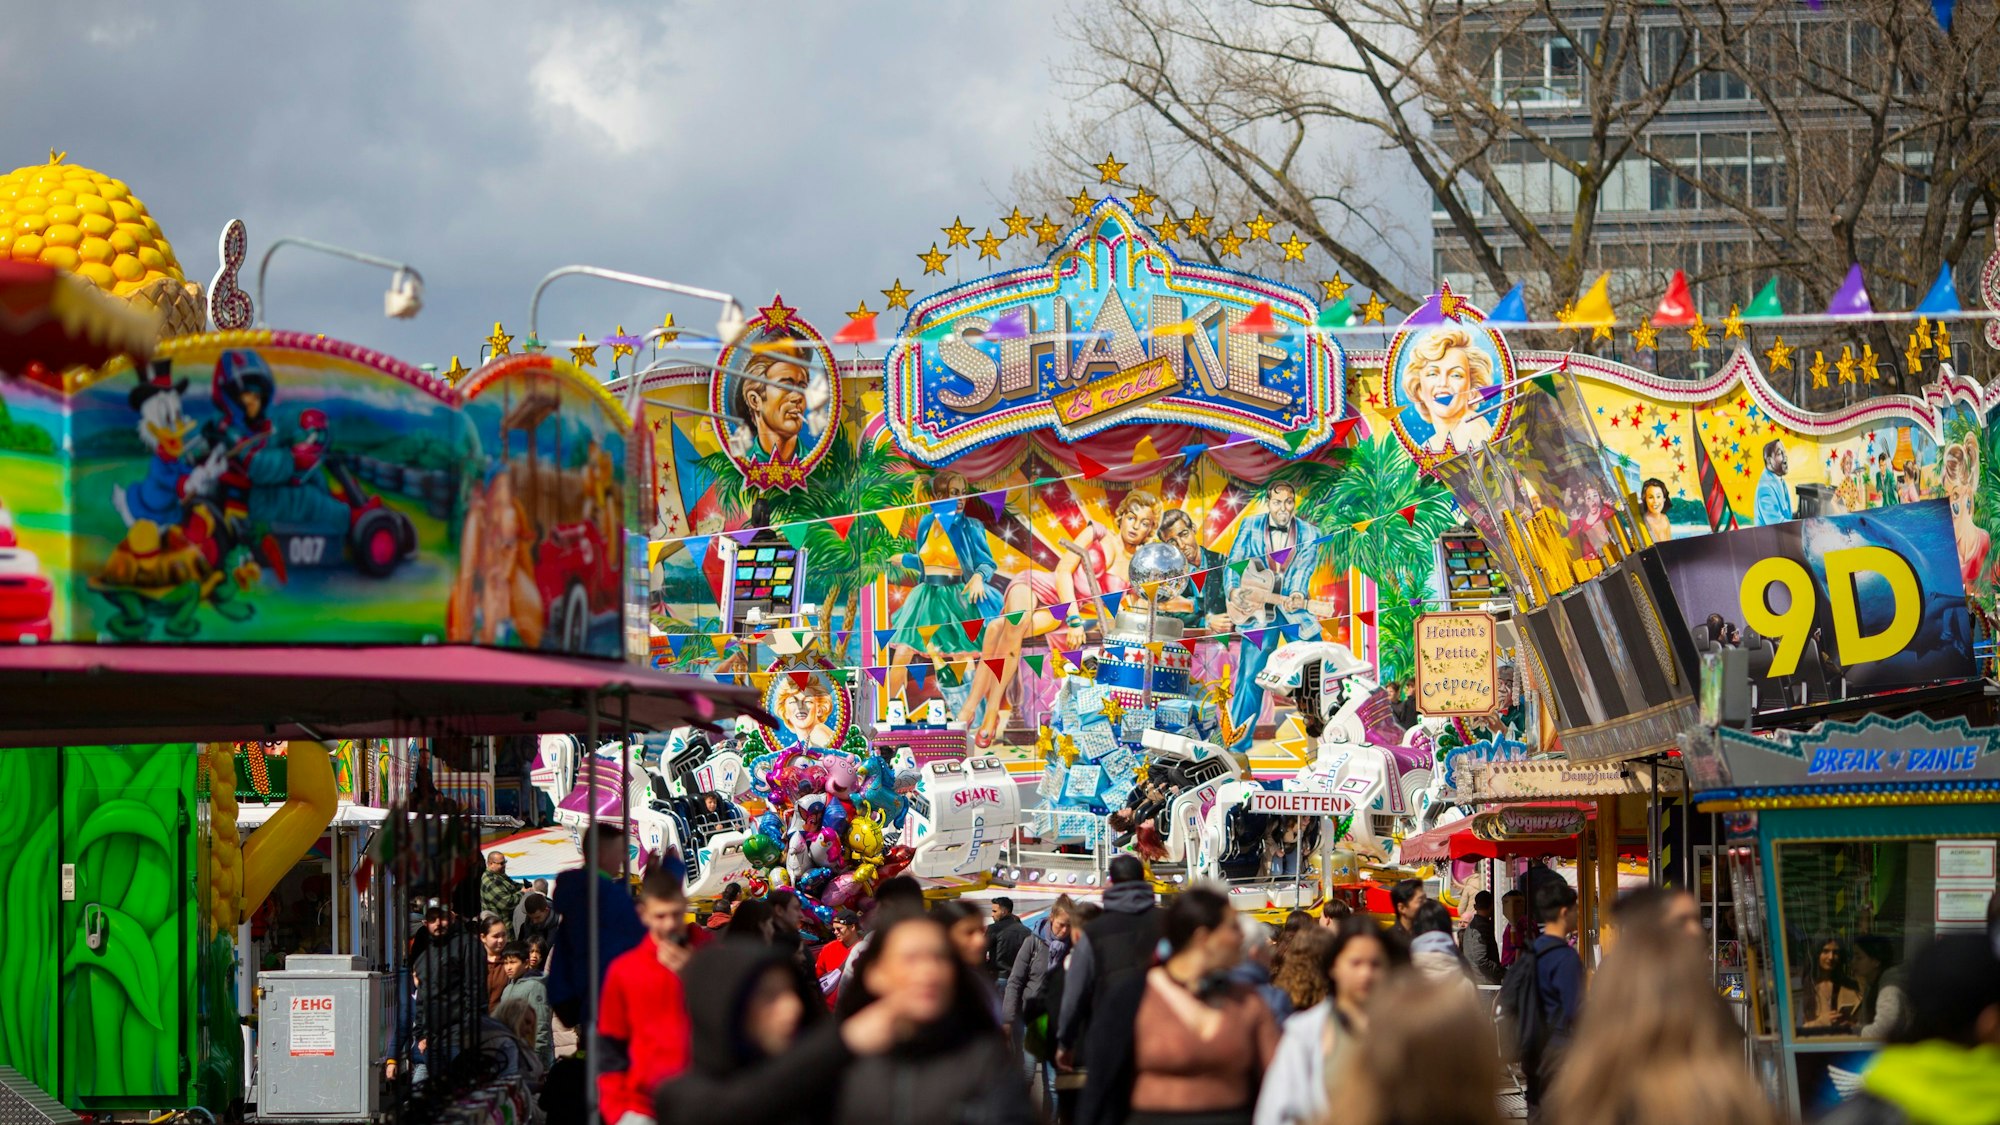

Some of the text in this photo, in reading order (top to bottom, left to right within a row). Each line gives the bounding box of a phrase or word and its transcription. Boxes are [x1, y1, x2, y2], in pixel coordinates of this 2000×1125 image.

[937, 282, 1293, 408] SHAKE
[1066, 361, 1164, 419] & roll
[289, 536, 326, 564] 007
[1739, 545, 1922, 679] 9D
[1425, 624, 1486, 640] Heinen's
[1434, 645, 1479, 660] Petite
[1423, 677, 1491, 697] Crêperie
[1807, 745, 1980, 776] BREAK DANCE
[954, 787, 1000, 808] SHAKE
[1255, 795, 1342, 812] TOILETTEN
[300, 998, 333, 1011] EHG
